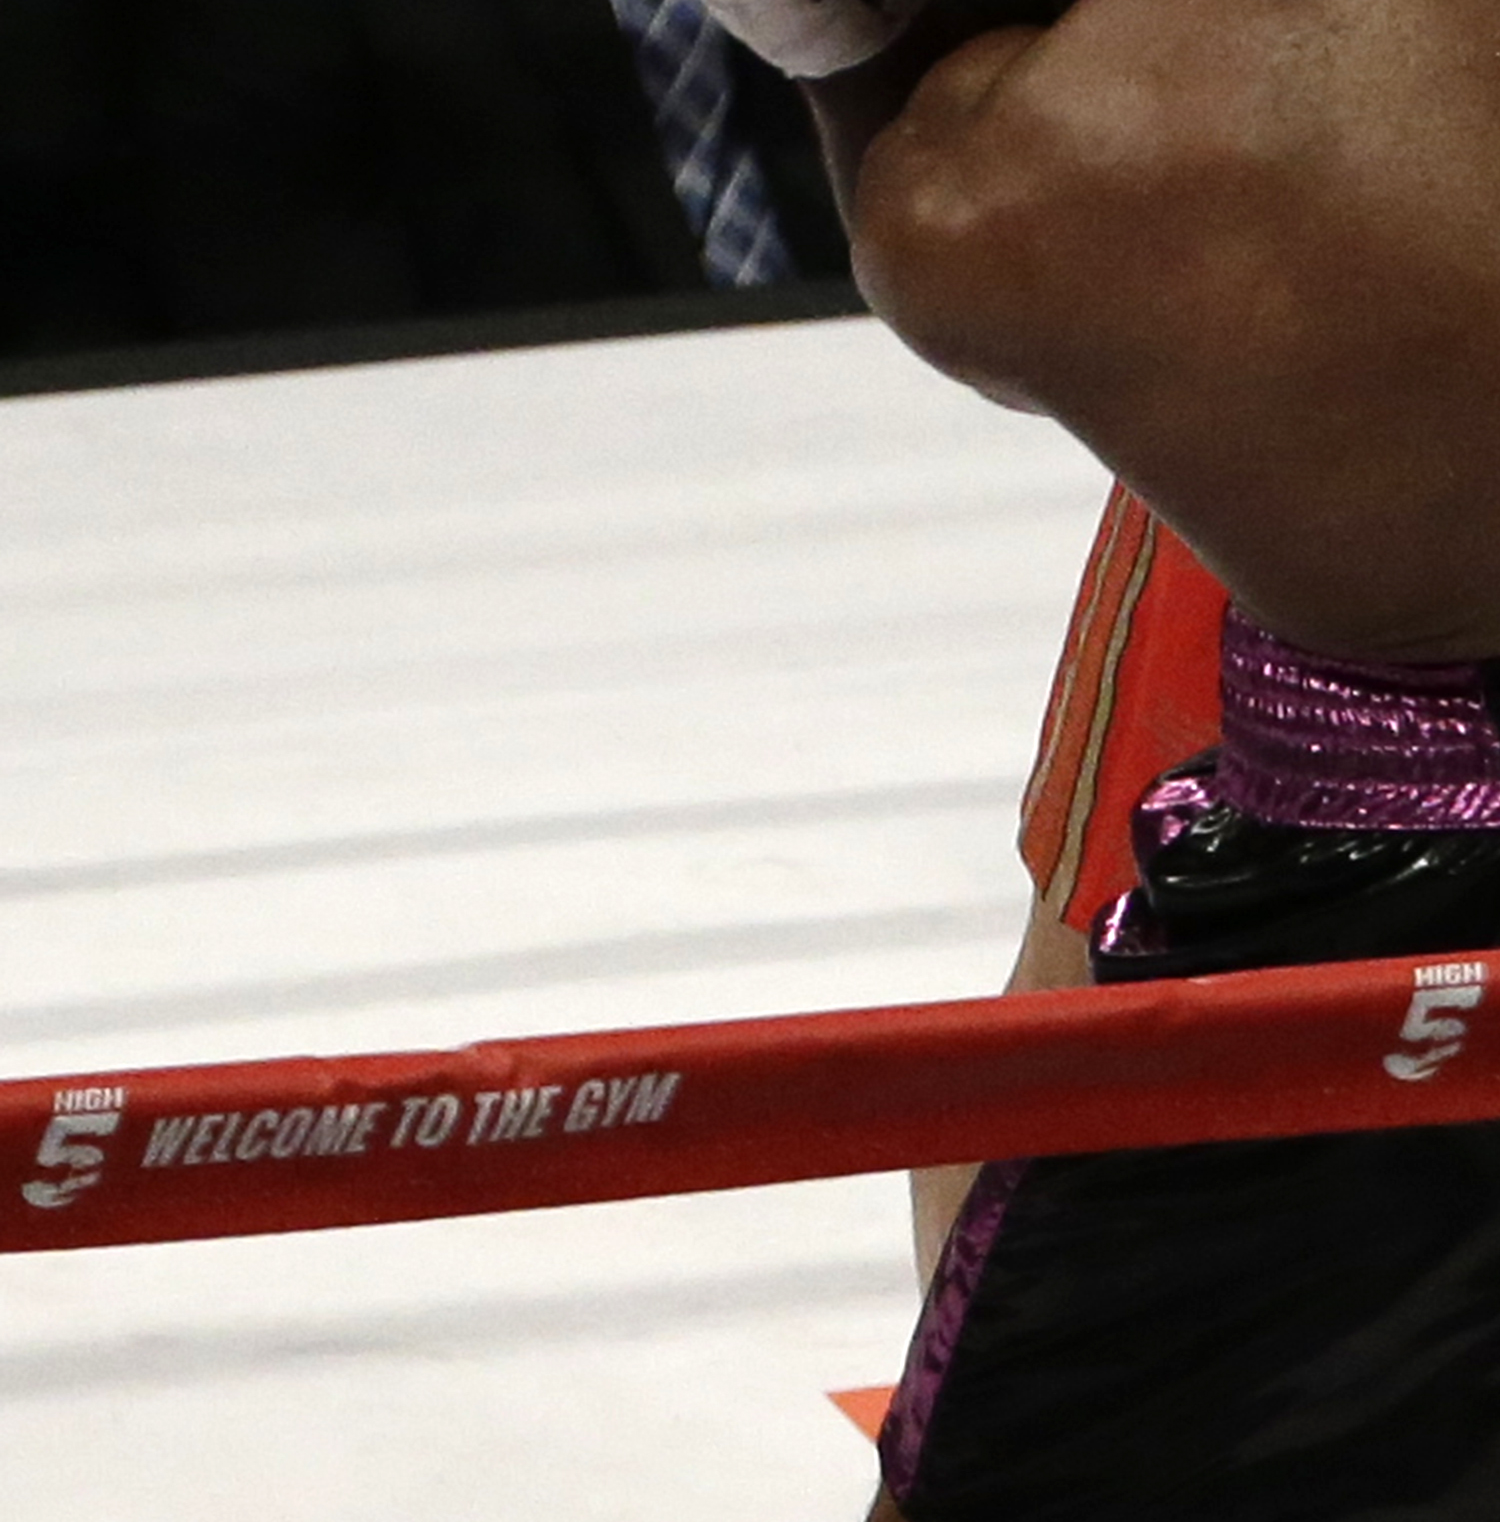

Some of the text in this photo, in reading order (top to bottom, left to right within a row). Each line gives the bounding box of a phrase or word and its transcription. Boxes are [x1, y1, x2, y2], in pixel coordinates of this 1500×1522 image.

[1414, 963, 1486, 986] HIGH
[1383, 986, 1483, 1080] 5
[53, 1087, 128, 1113] HIGH
[142, 1072, 681, 1169] WELCOME TO THE GYM
[22, 1114, 119, 1209] 5
